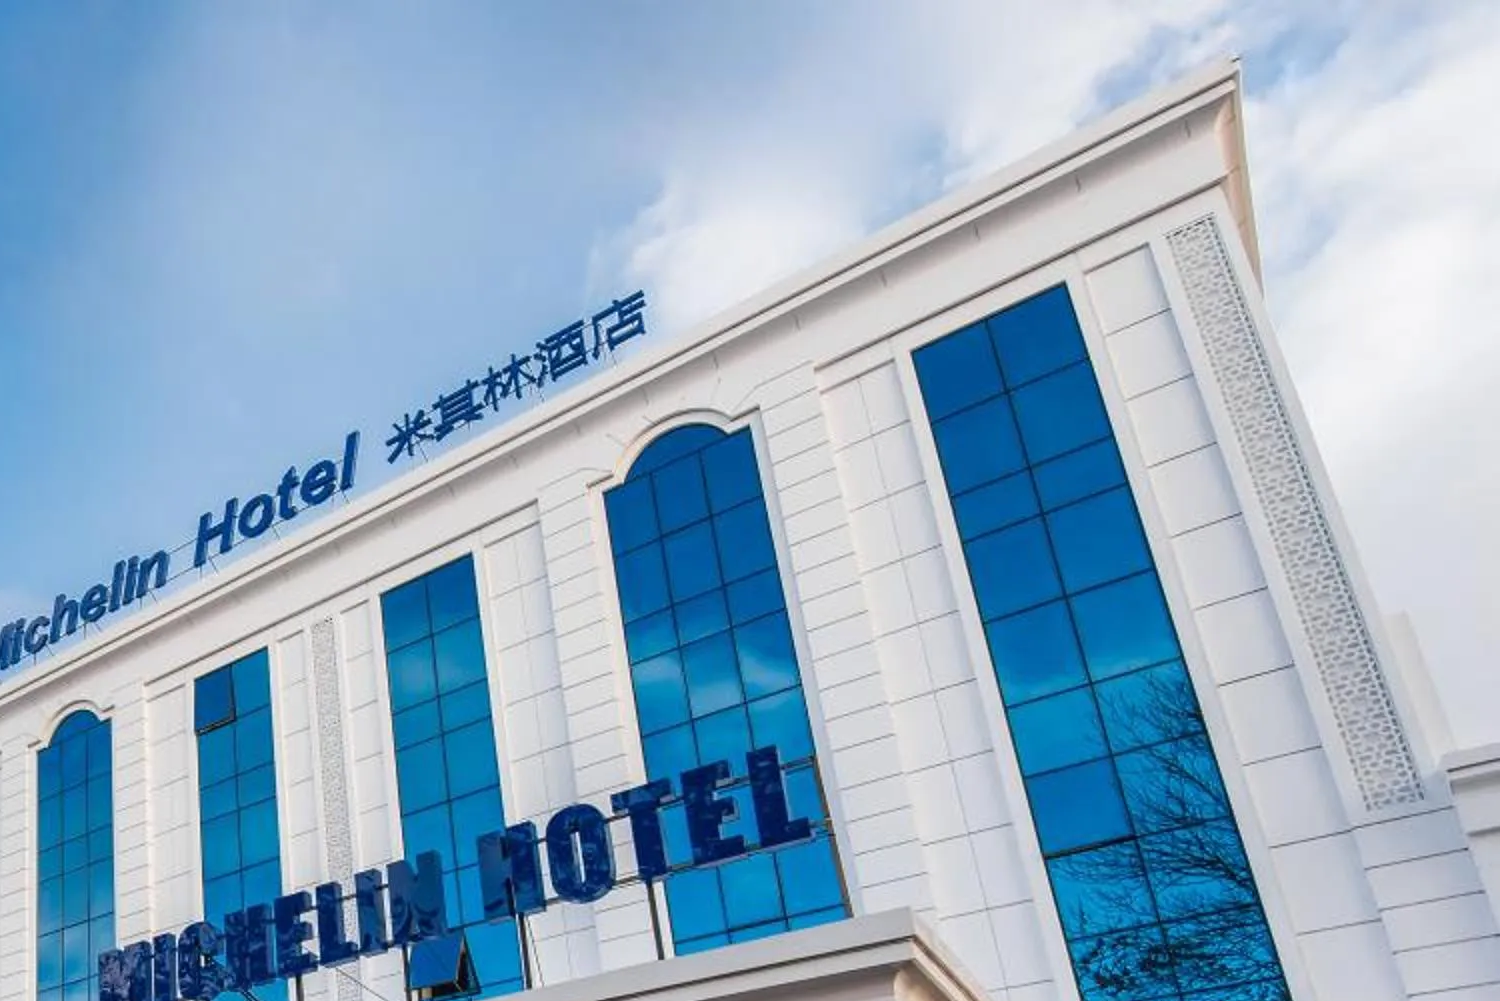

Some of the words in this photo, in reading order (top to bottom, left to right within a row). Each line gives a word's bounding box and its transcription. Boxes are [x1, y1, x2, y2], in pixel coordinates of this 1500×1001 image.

[385, 289, 647, 465] 米其林酒店
[193, 430, 361, 568] Hotel
[476, 744, 813, 921] HOTEL
